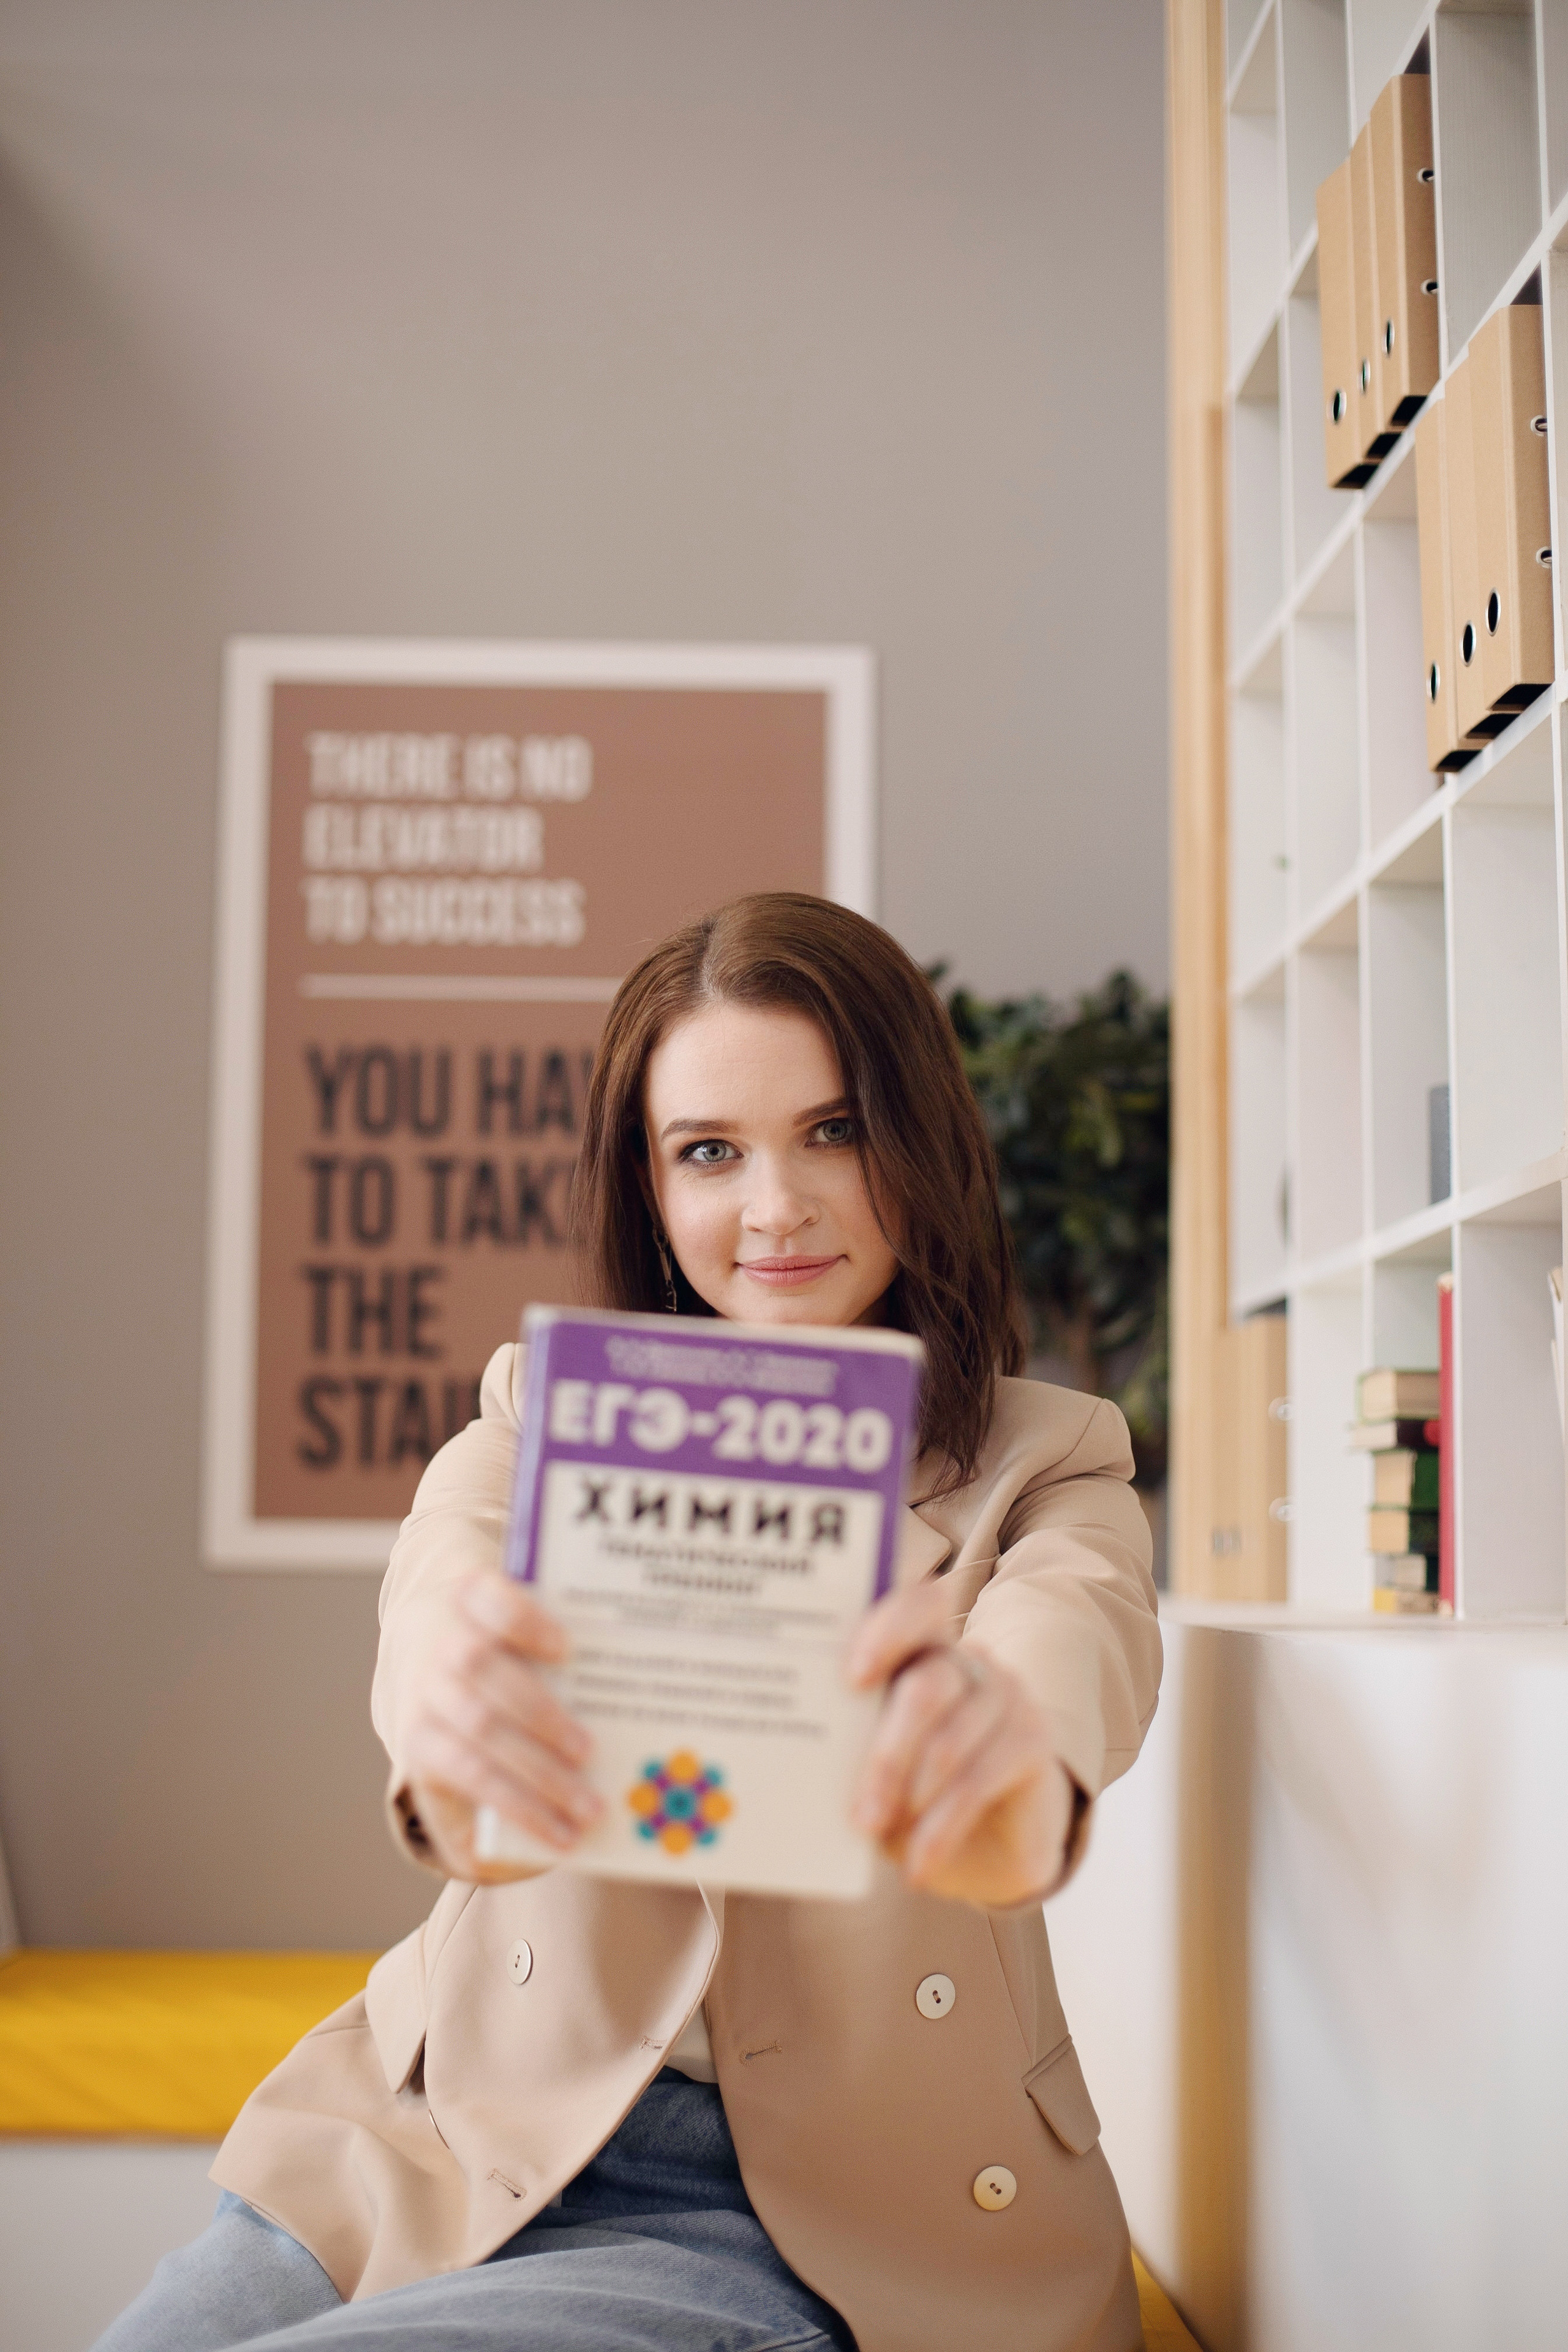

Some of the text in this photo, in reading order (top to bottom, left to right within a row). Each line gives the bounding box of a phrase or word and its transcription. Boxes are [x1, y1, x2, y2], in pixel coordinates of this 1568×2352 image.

[307, 731, 592, 802] THERE IS NO
[304, 803, 543, 873] ELEVATOR
[302, 874, 586, 948] TO SUCCESS
[306, 1041, 453, 1138] YOU
[301, 1150, 579, 1248] TO TAK
[300, 1261, 442, 1360] THE
[298, 1374, 481, 1468] STAI
[549, 1376, 894, 1474] ЕГЭ-2020
[576, 1472, 851, 1547] ХИМИЯ
